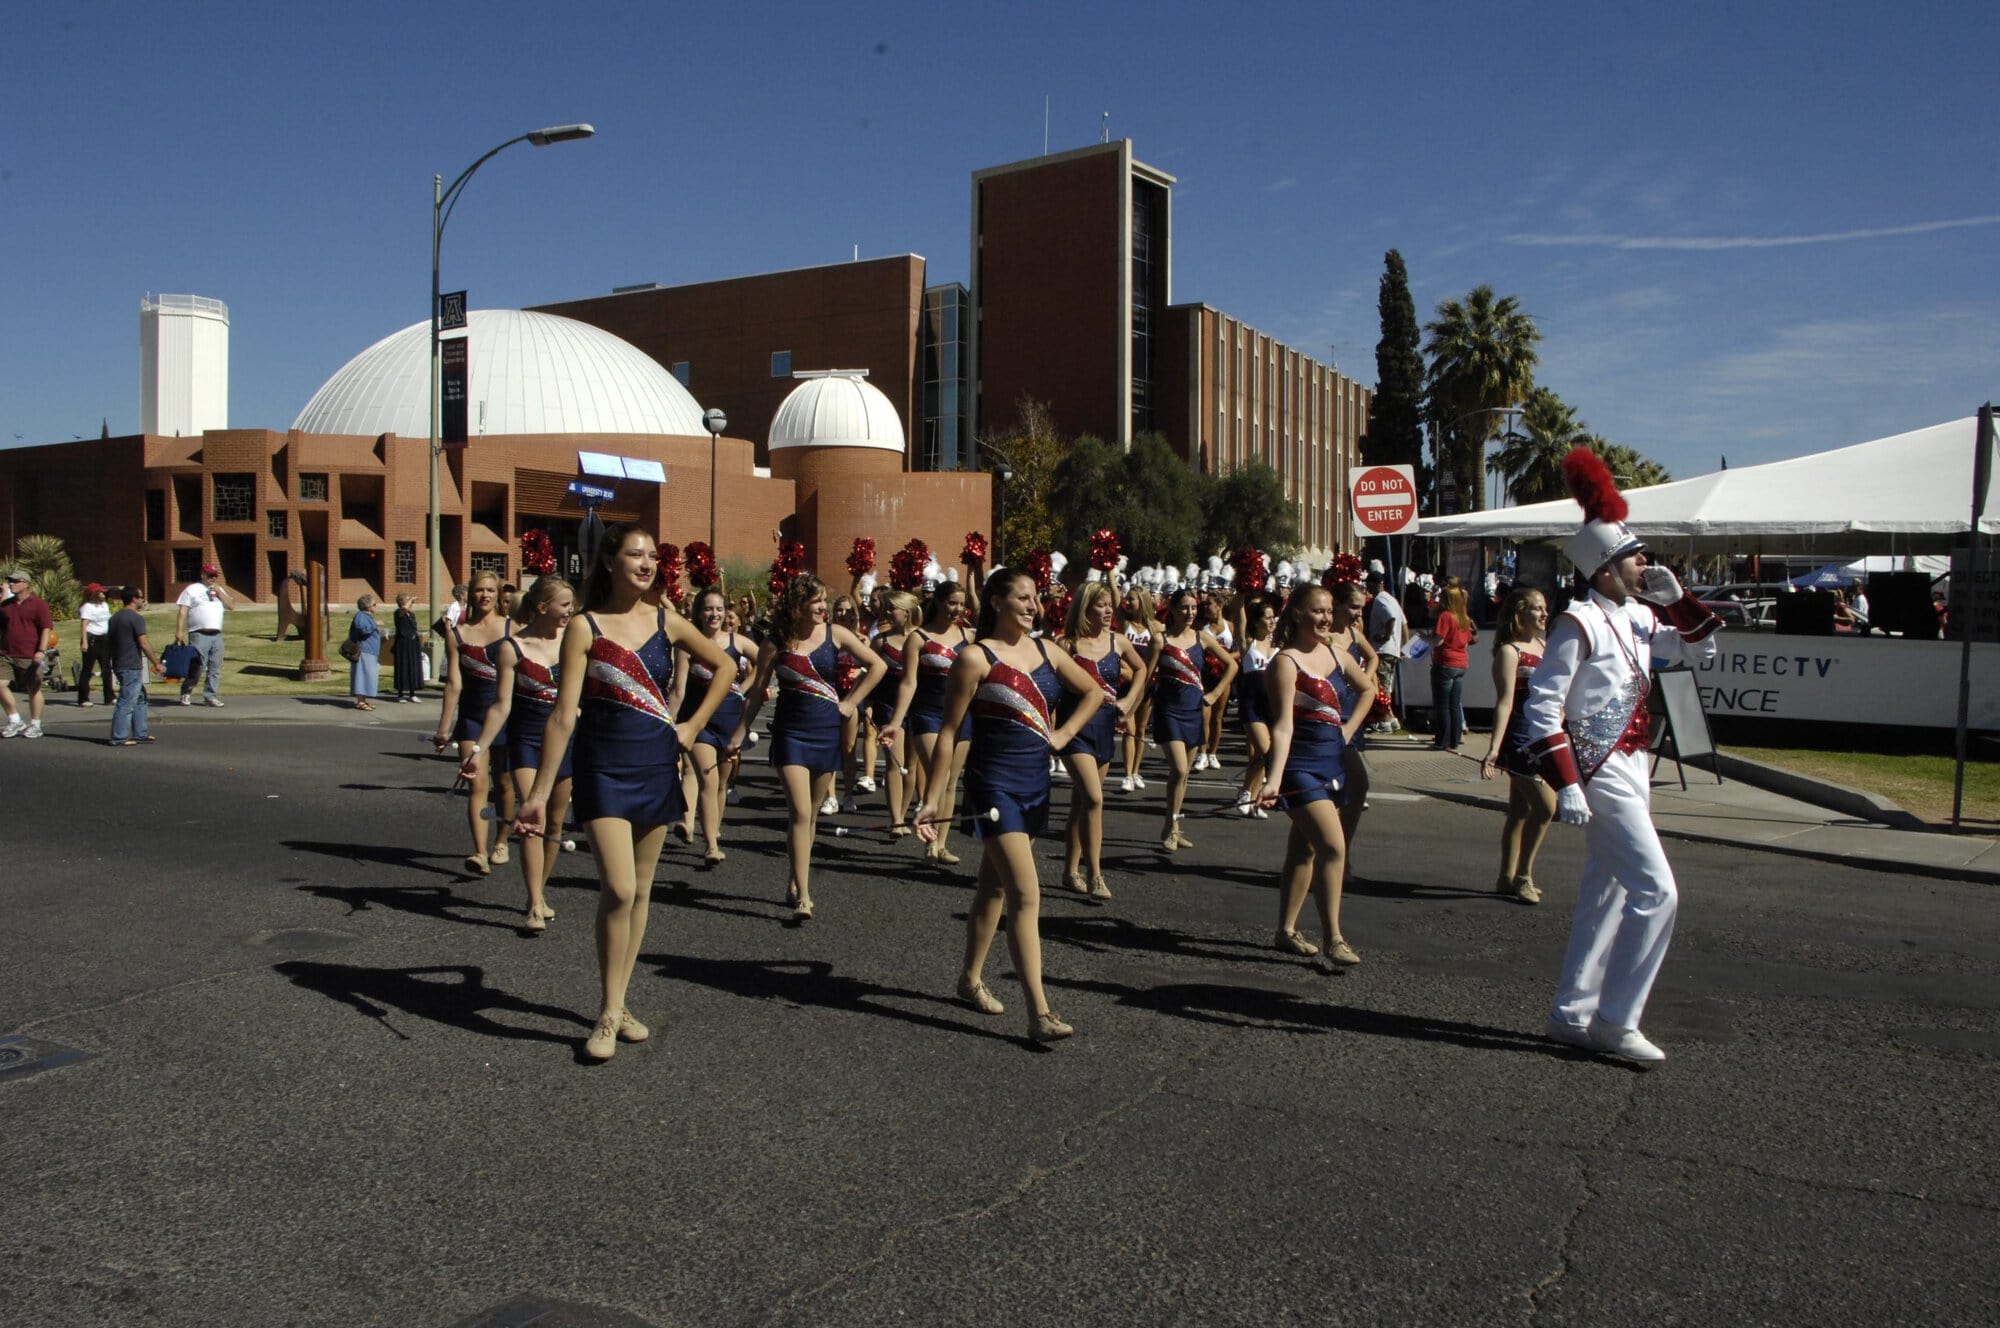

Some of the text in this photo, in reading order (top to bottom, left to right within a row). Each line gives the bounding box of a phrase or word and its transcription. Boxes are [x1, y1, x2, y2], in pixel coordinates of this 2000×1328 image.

[1360, 479, 1404, 492] DO NOT
[1367, 509, 1403, 522] ENTER
